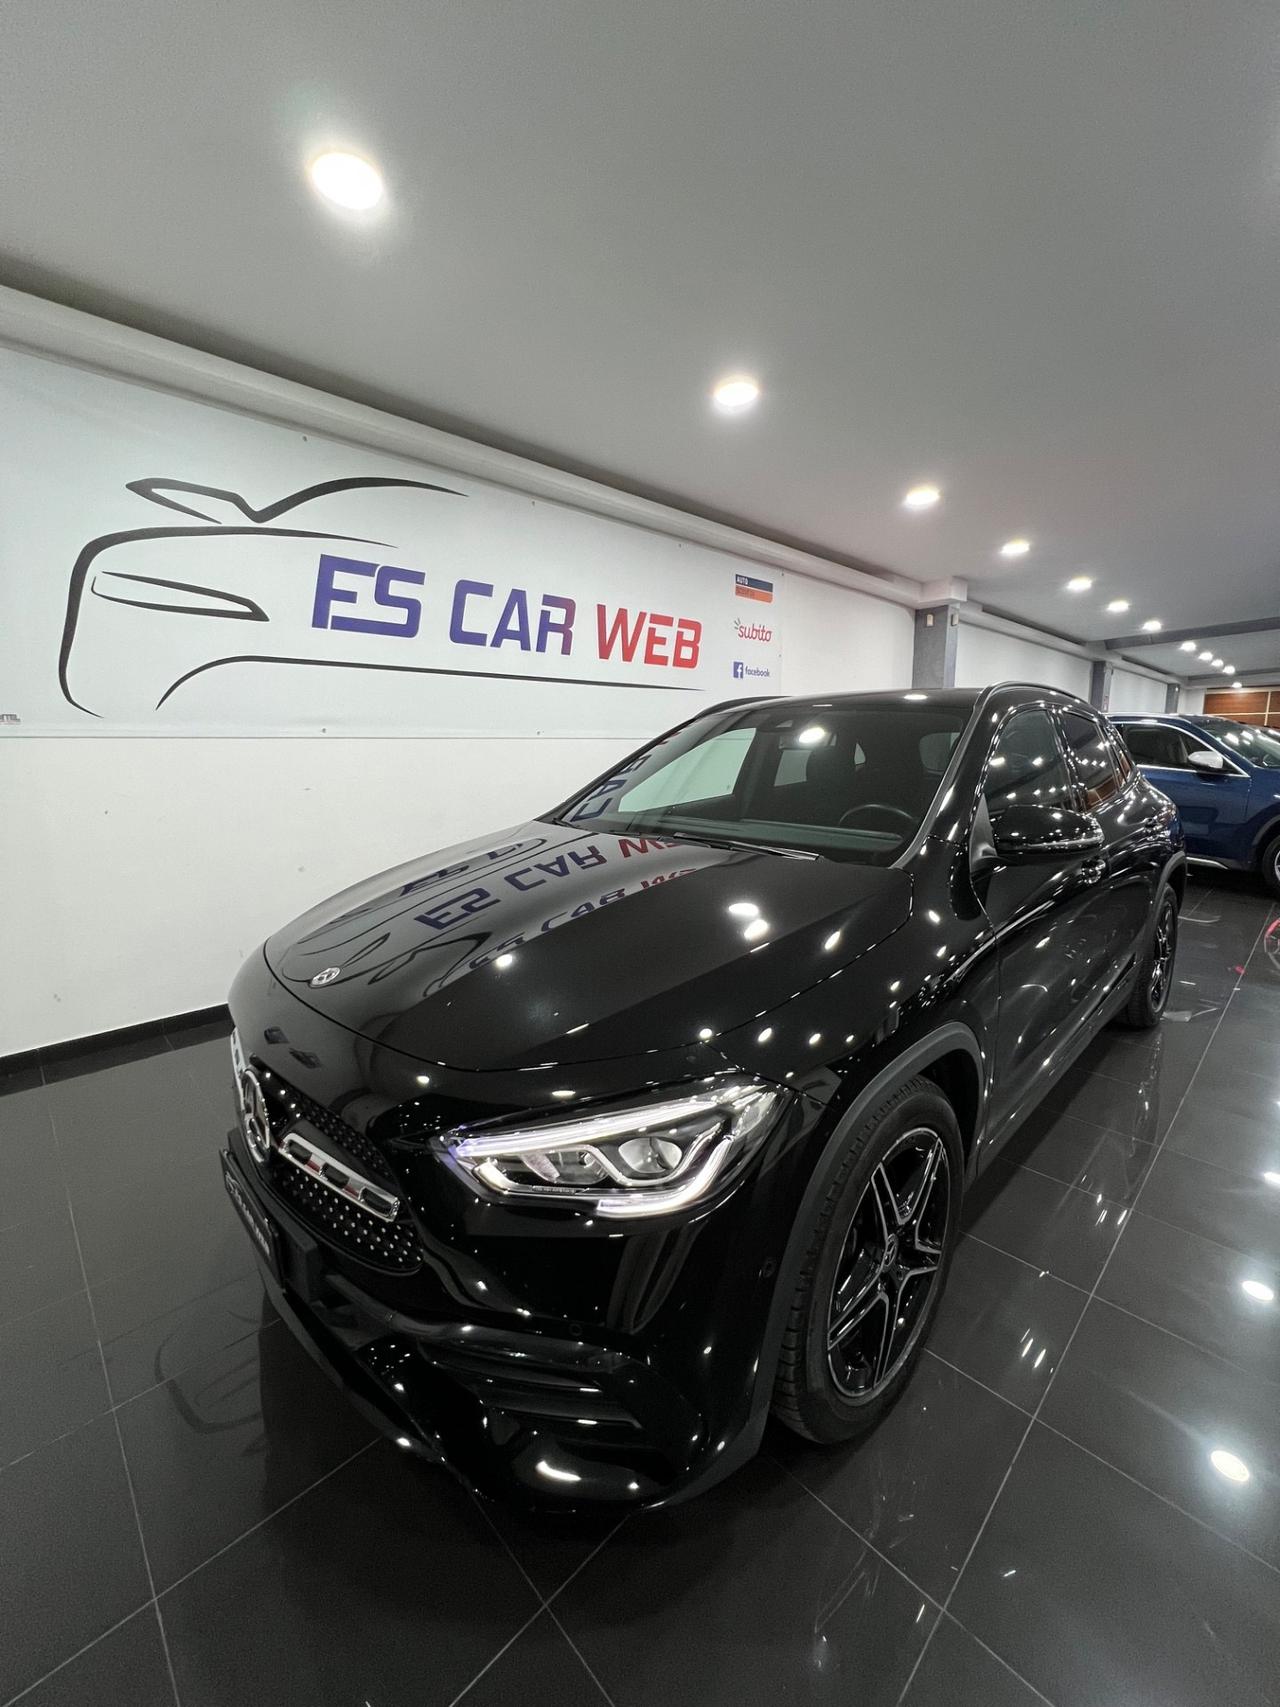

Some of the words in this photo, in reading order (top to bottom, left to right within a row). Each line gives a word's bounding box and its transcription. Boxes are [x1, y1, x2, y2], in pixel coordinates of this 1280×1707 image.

[312, 554, 426, 639] ES
[449, 579, 577, 656] CAR
[596, 603, 702, 669] WEB
[738, 624, 772, 642] subito
[745, 665, 770, 677] facebook
